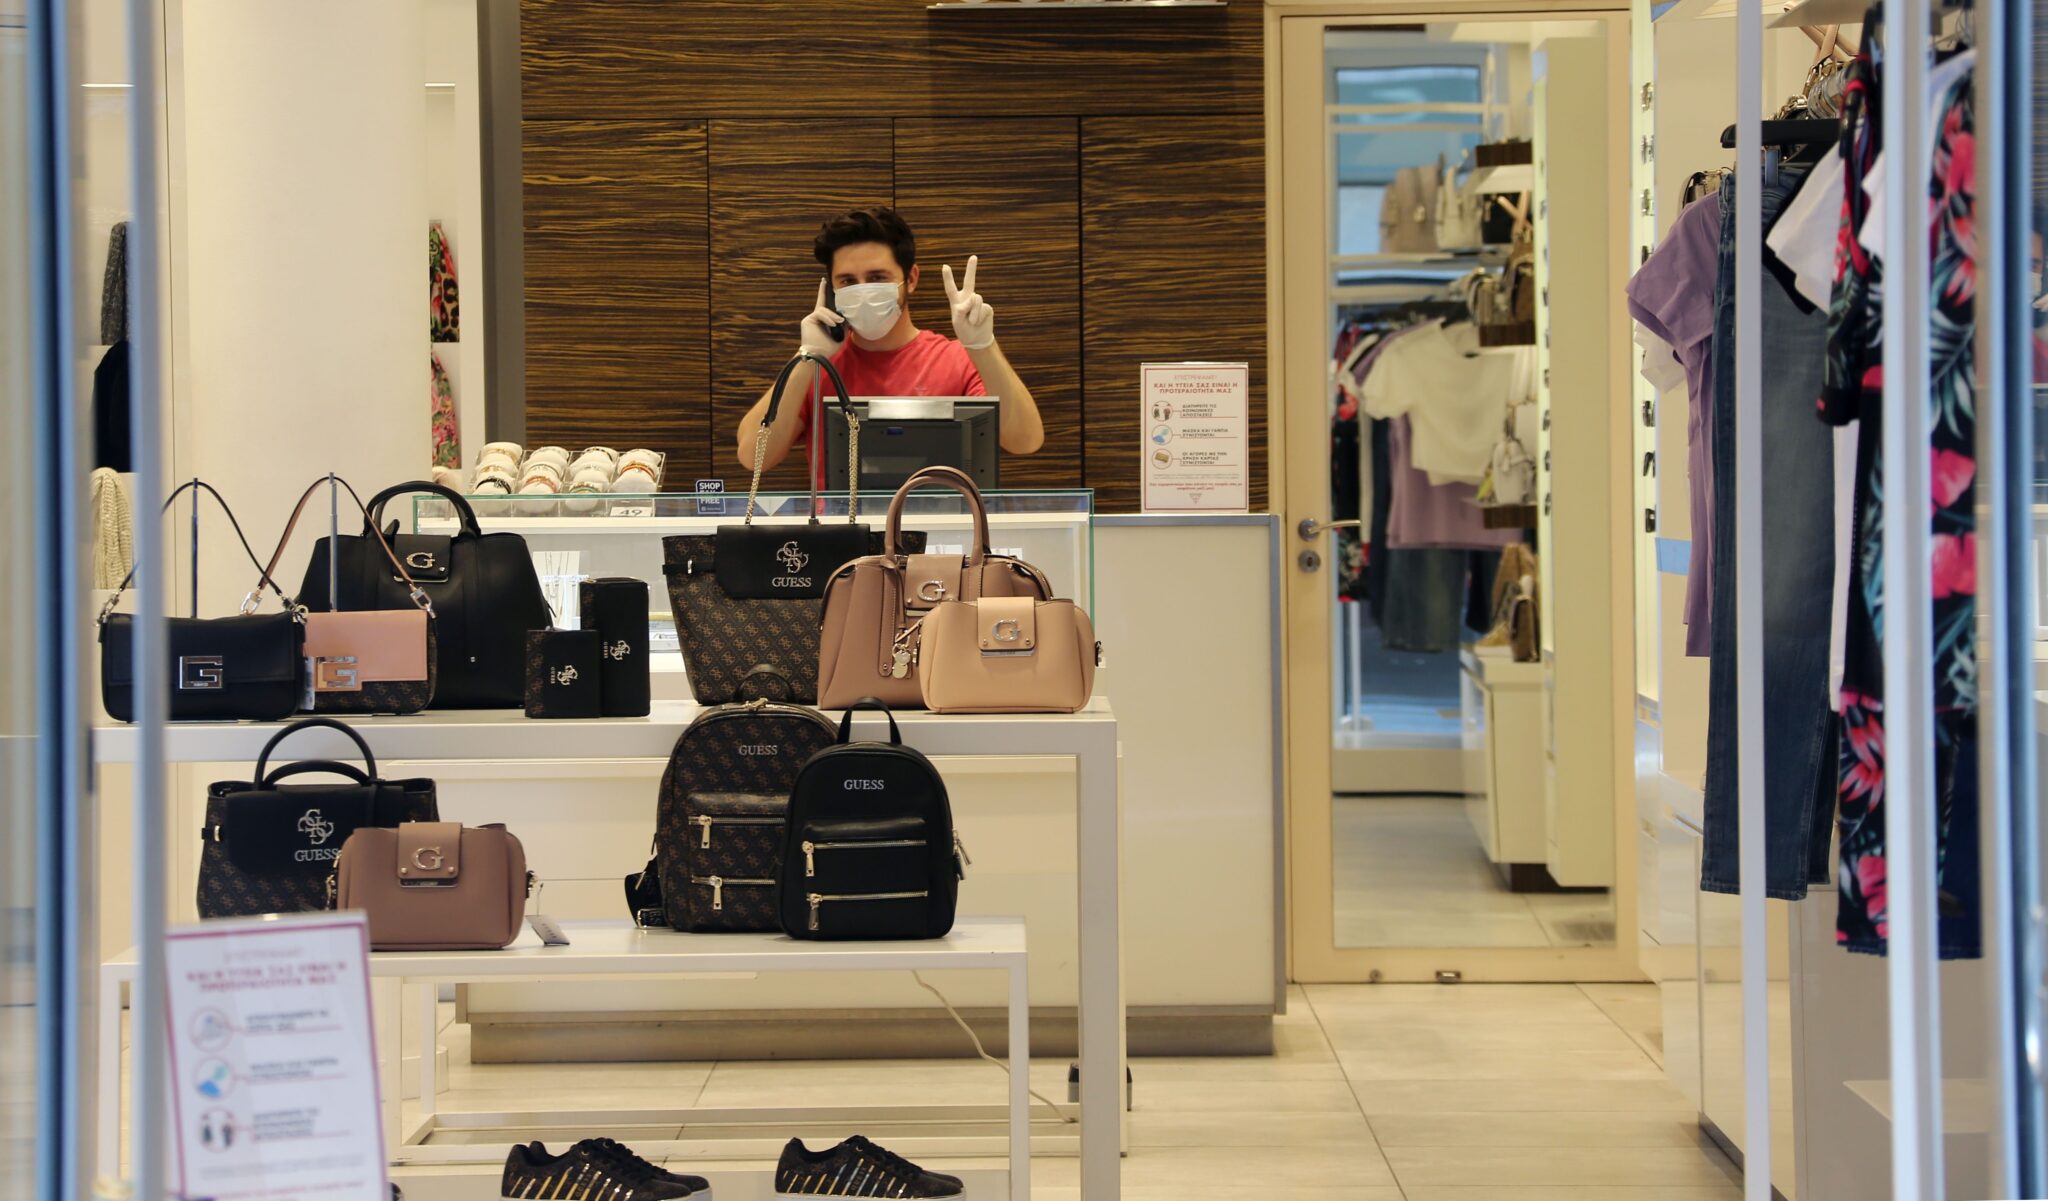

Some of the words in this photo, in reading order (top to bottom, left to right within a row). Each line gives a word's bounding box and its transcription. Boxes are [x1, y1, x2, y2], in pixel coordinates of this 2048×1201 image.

[406, 552, 435, 568] G
[772, 577, 812, 588] GUESS
[917, 580, 945, 601] G
[992, 619, 1020, 642] G
[180, 656, 223, 689] G
[739, 745, 778, 756] GUESS
[844, 780, 884, 790] GUESS
[294, 848, 341, 862] GUESS
[412, 846, 444, 870] G
